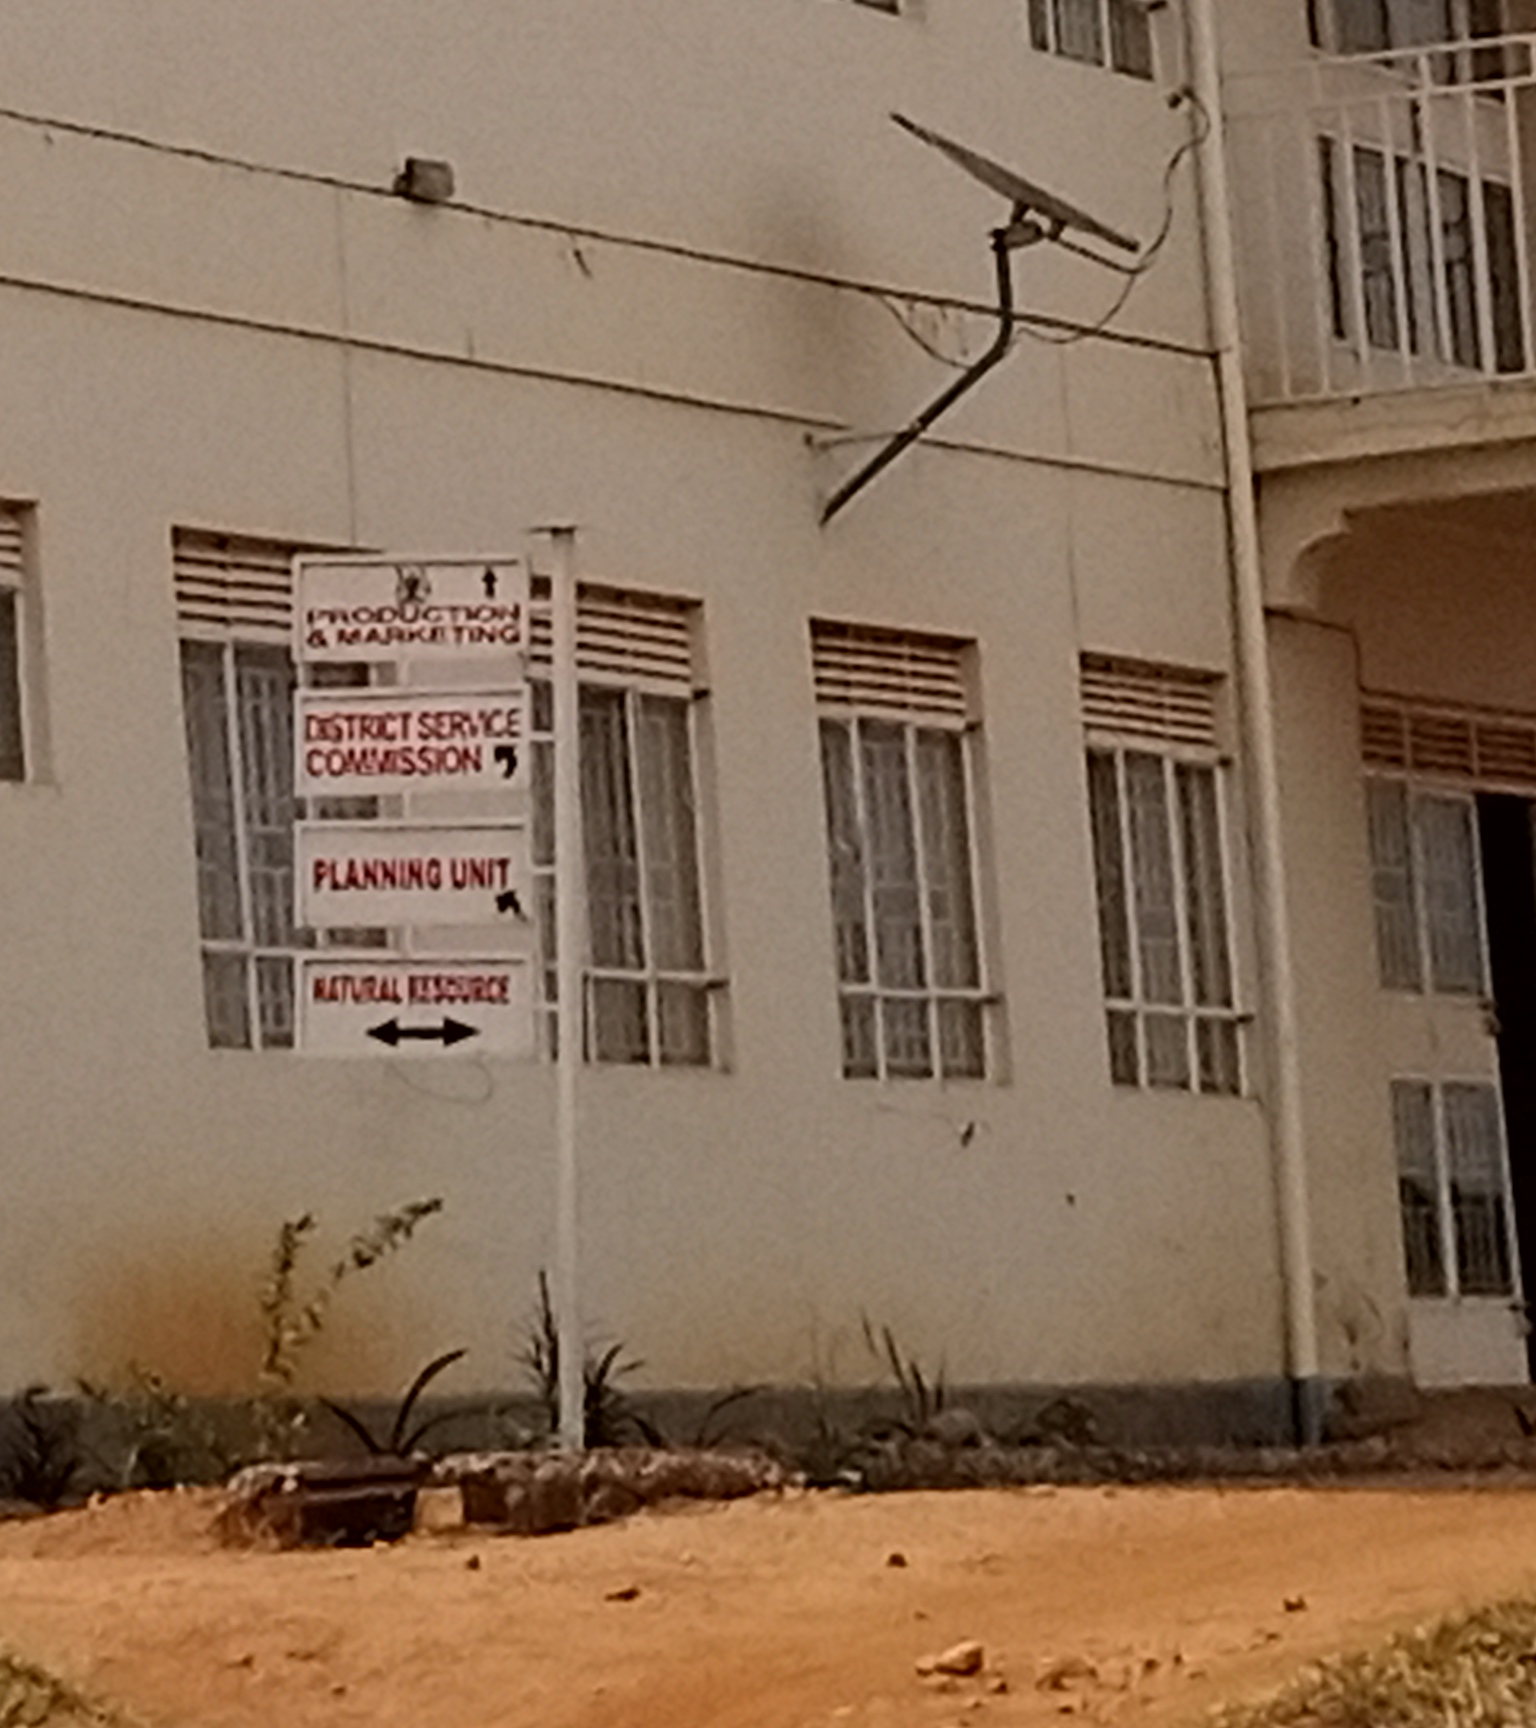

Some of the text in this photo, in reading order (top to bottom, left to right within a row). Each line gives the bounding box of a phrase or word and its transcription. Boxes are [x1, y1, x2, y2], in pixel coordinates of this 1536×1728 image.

[306, 603, 520, 624] PRODUCTION
[306, 625, 520, 648] & MARKETING
[305, 708, 521, 742] DISTRICT SERVICE
[306, 745, 482, 776] COMMISSION
[314, 858, 510, 891] PLANNING UNIT
[314, 975, 402, 1004] NATURAL
